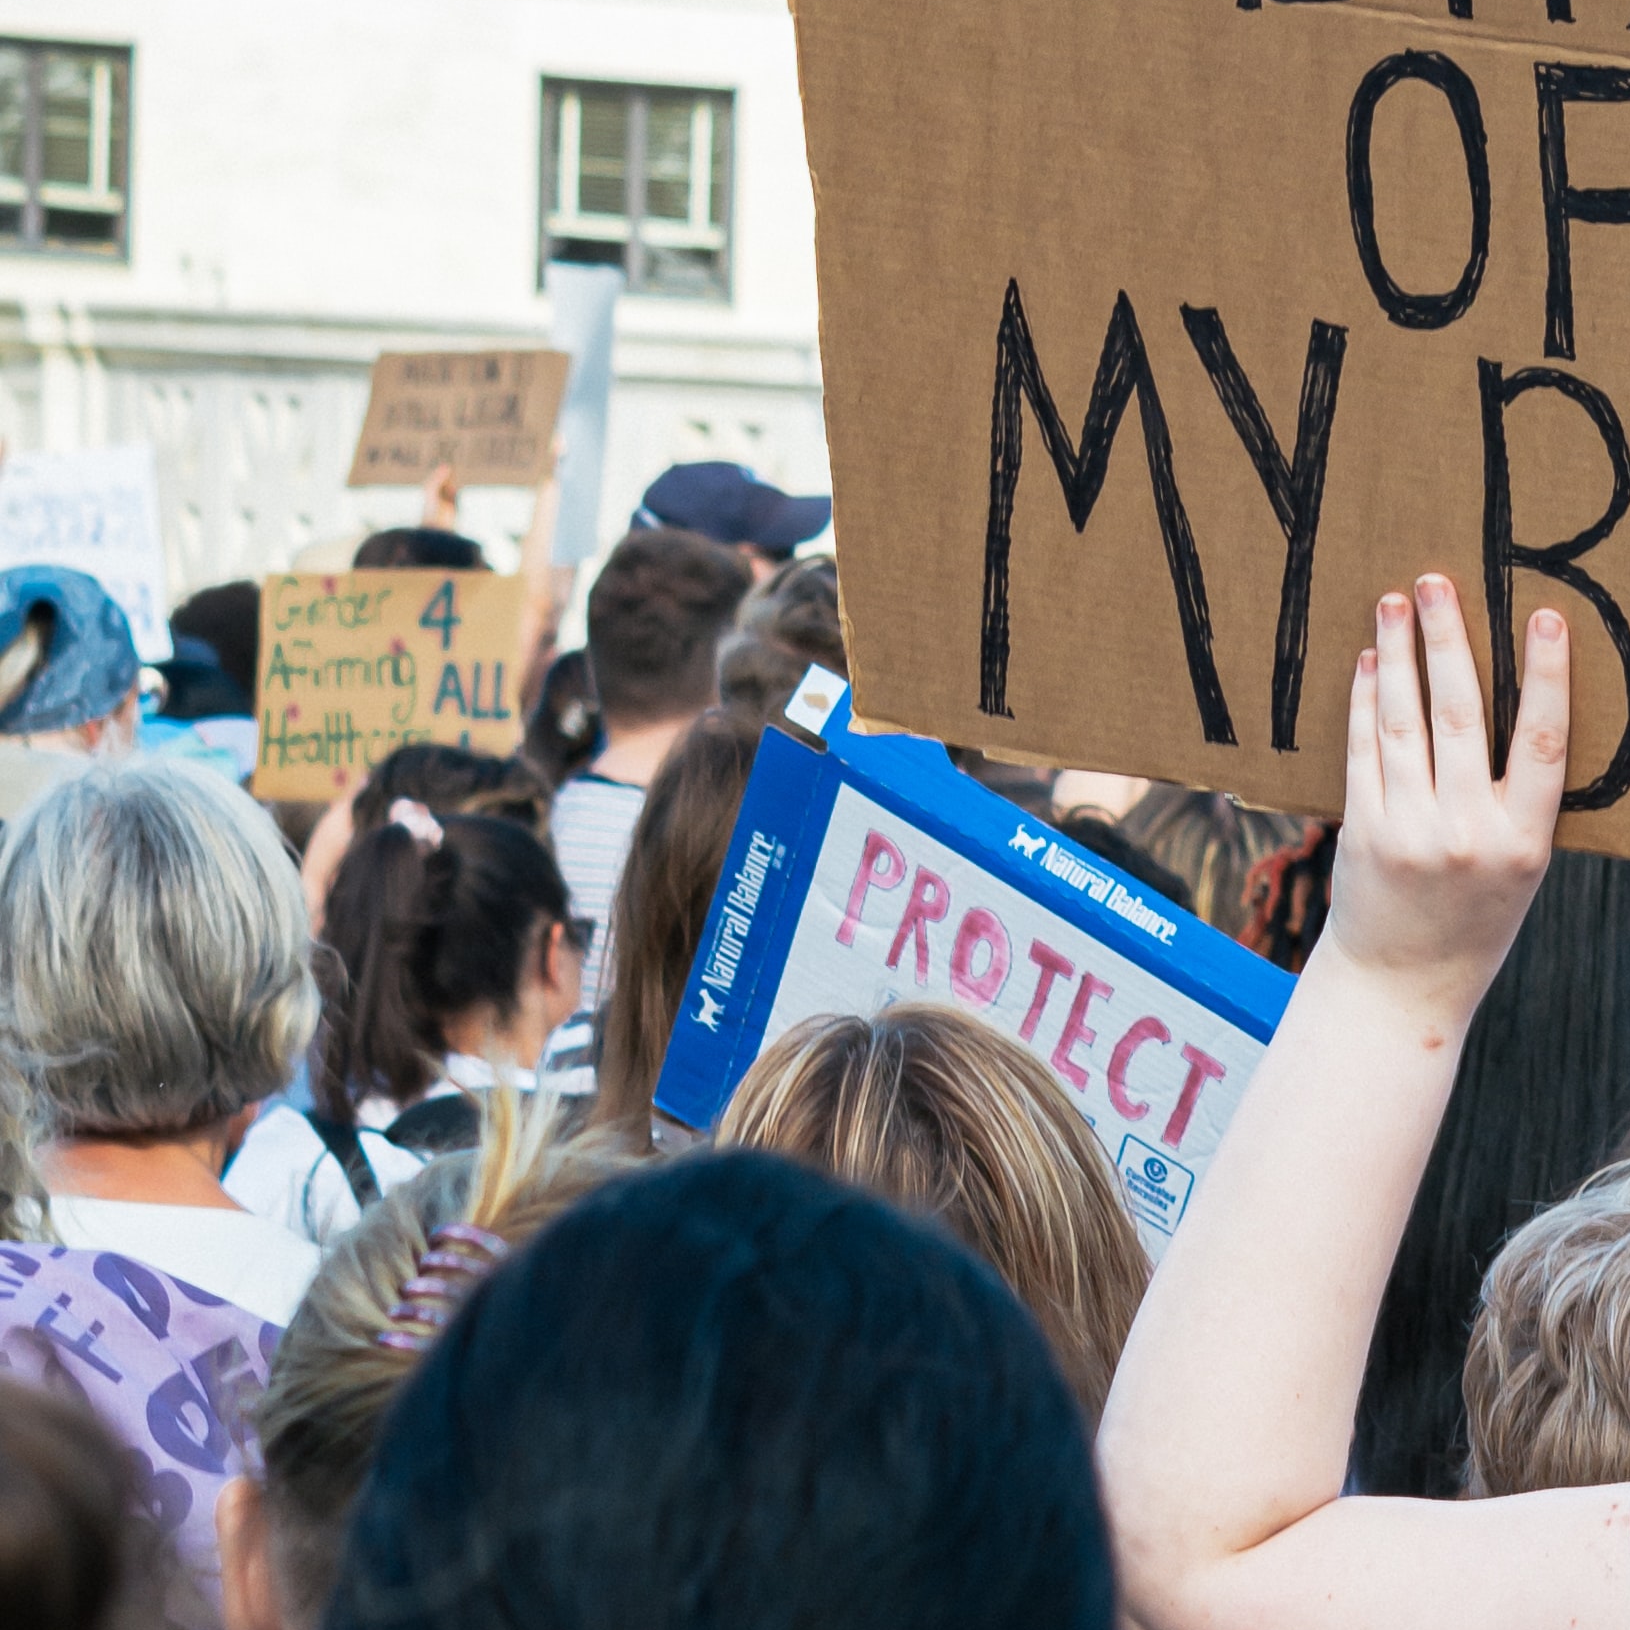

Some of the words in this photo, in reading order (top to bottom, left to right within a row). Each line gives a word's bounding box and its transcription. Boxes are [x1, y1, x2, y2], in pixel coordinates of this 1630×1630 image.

[978, 276, 1349, 752] MY
[274, 576, 392, 631] Gender
[418, 579, 462, 651] 4
[433, 661, 511, 720] ALL
[701, 906, 752, 996] Natural
[727, 830, 776, 916] Balance
[1040, 841, 1116, 903] Natural
[1106, 883, 1177, 946] Balance
[835, 828, 1226, 1149] PROTECT
